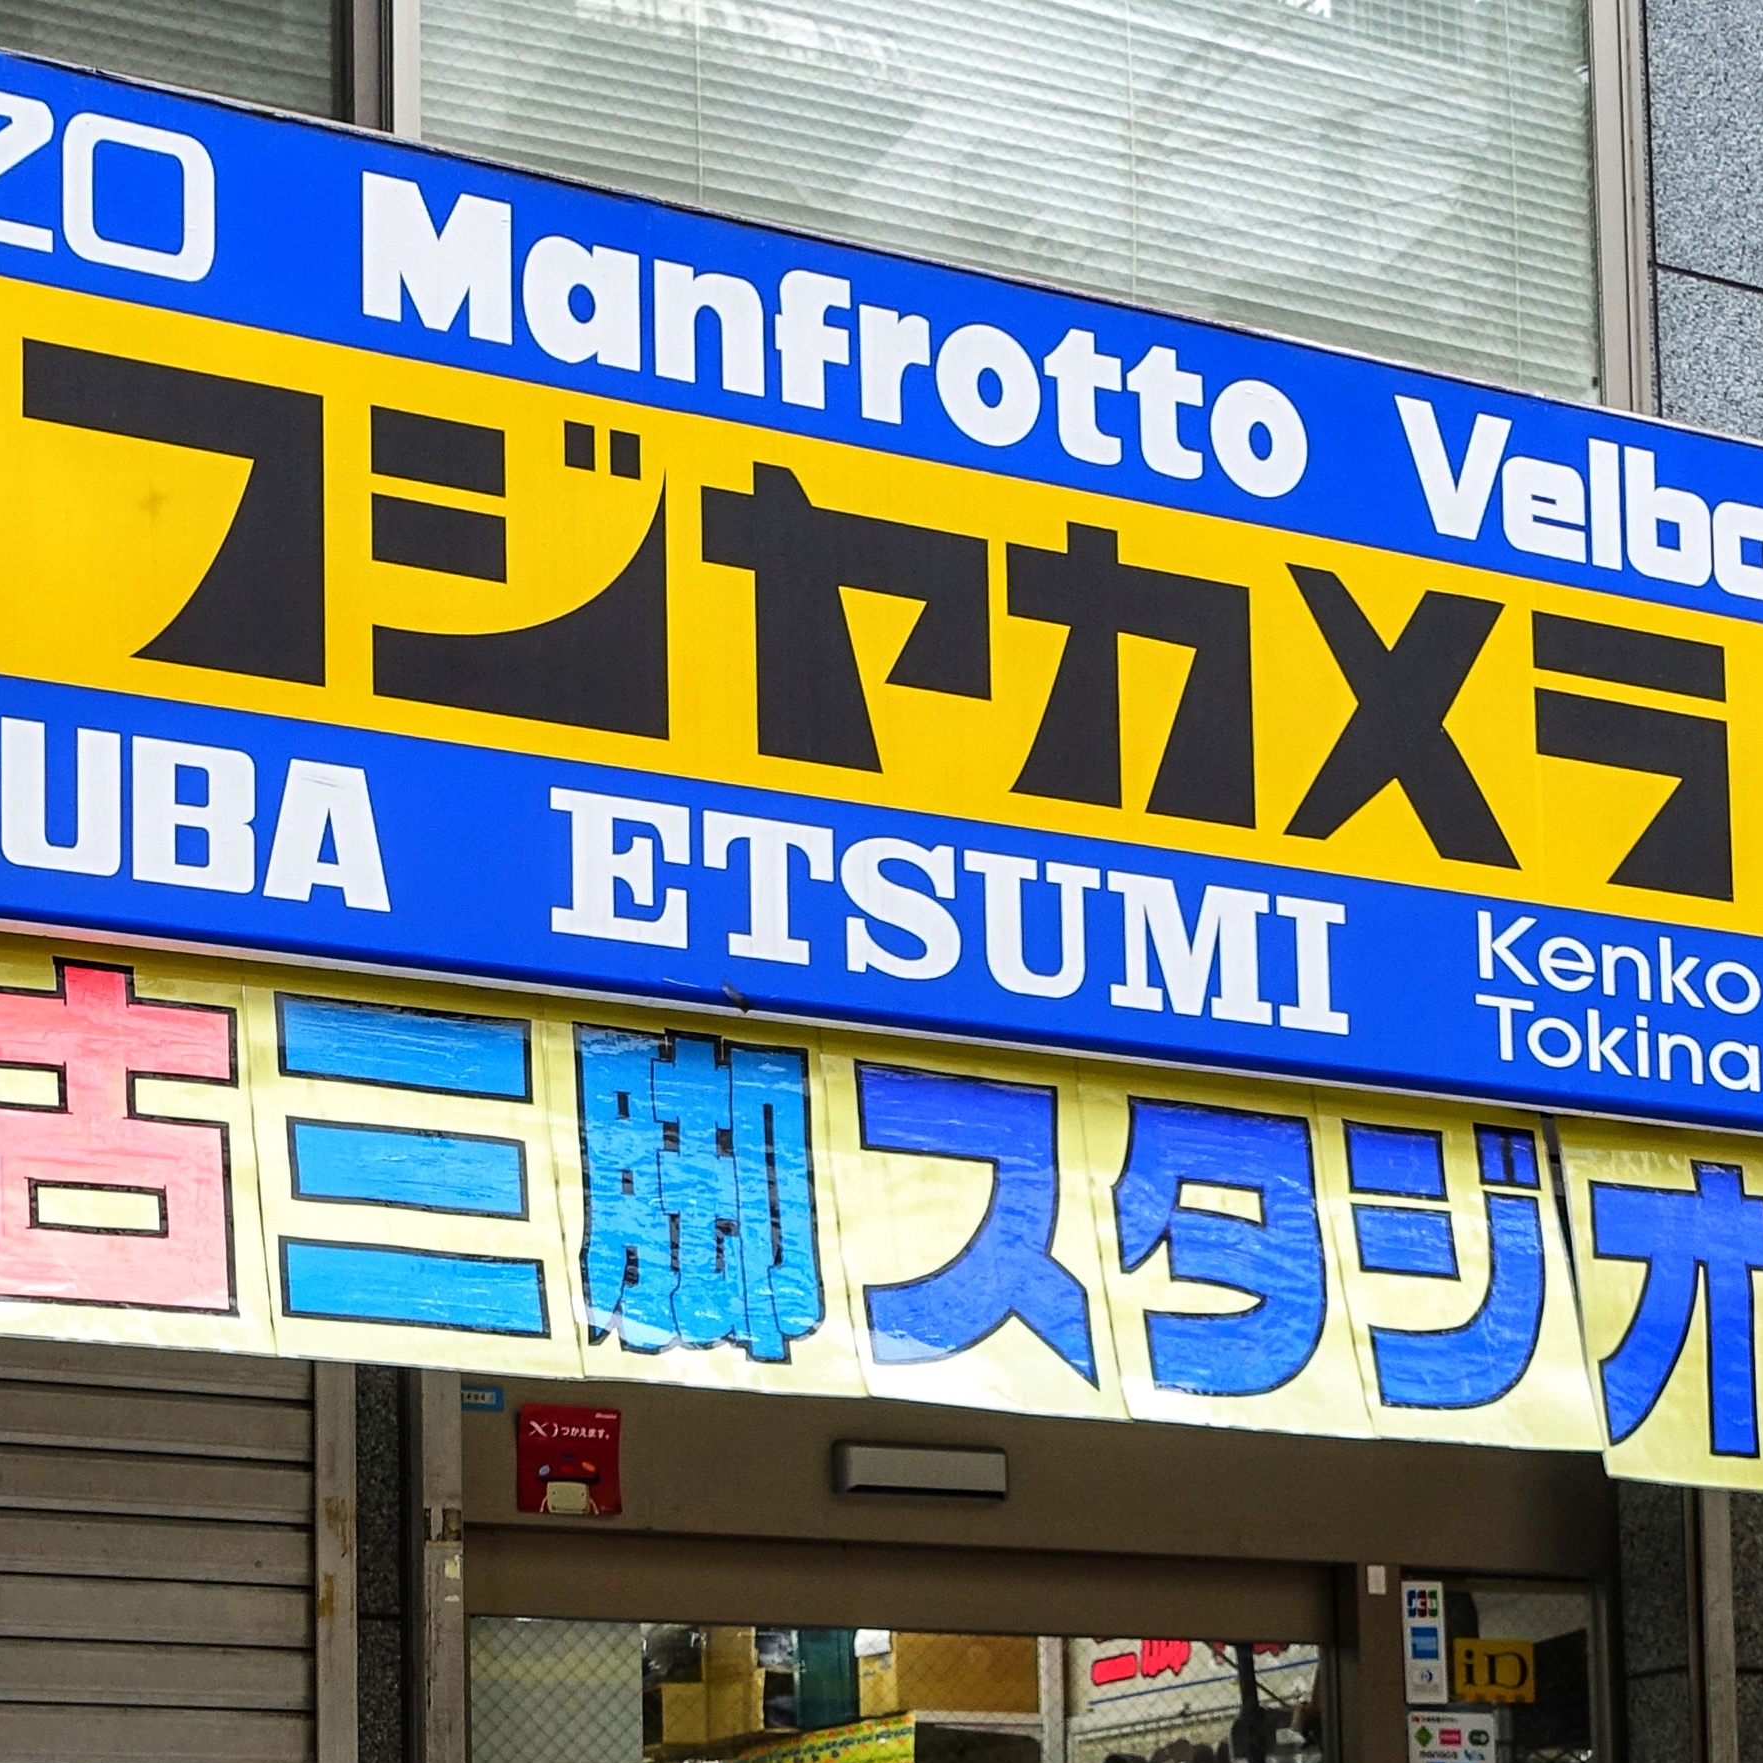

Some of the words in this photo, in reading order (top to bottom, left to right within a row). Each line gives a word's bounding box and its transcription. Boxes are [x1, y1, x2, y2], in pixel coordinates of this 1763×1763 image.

[362, 170, 1307, 498] Manfrotto
[22, 338, 1734, 902] フジヤカメラ
[549, 787, 1347, 1036] ETSUMI
[1476, 910, 1762, 1014] Kenko
[1475, 994, 1762, 1093] Tokina
[1462, 1649, 1528, 1690] iD
